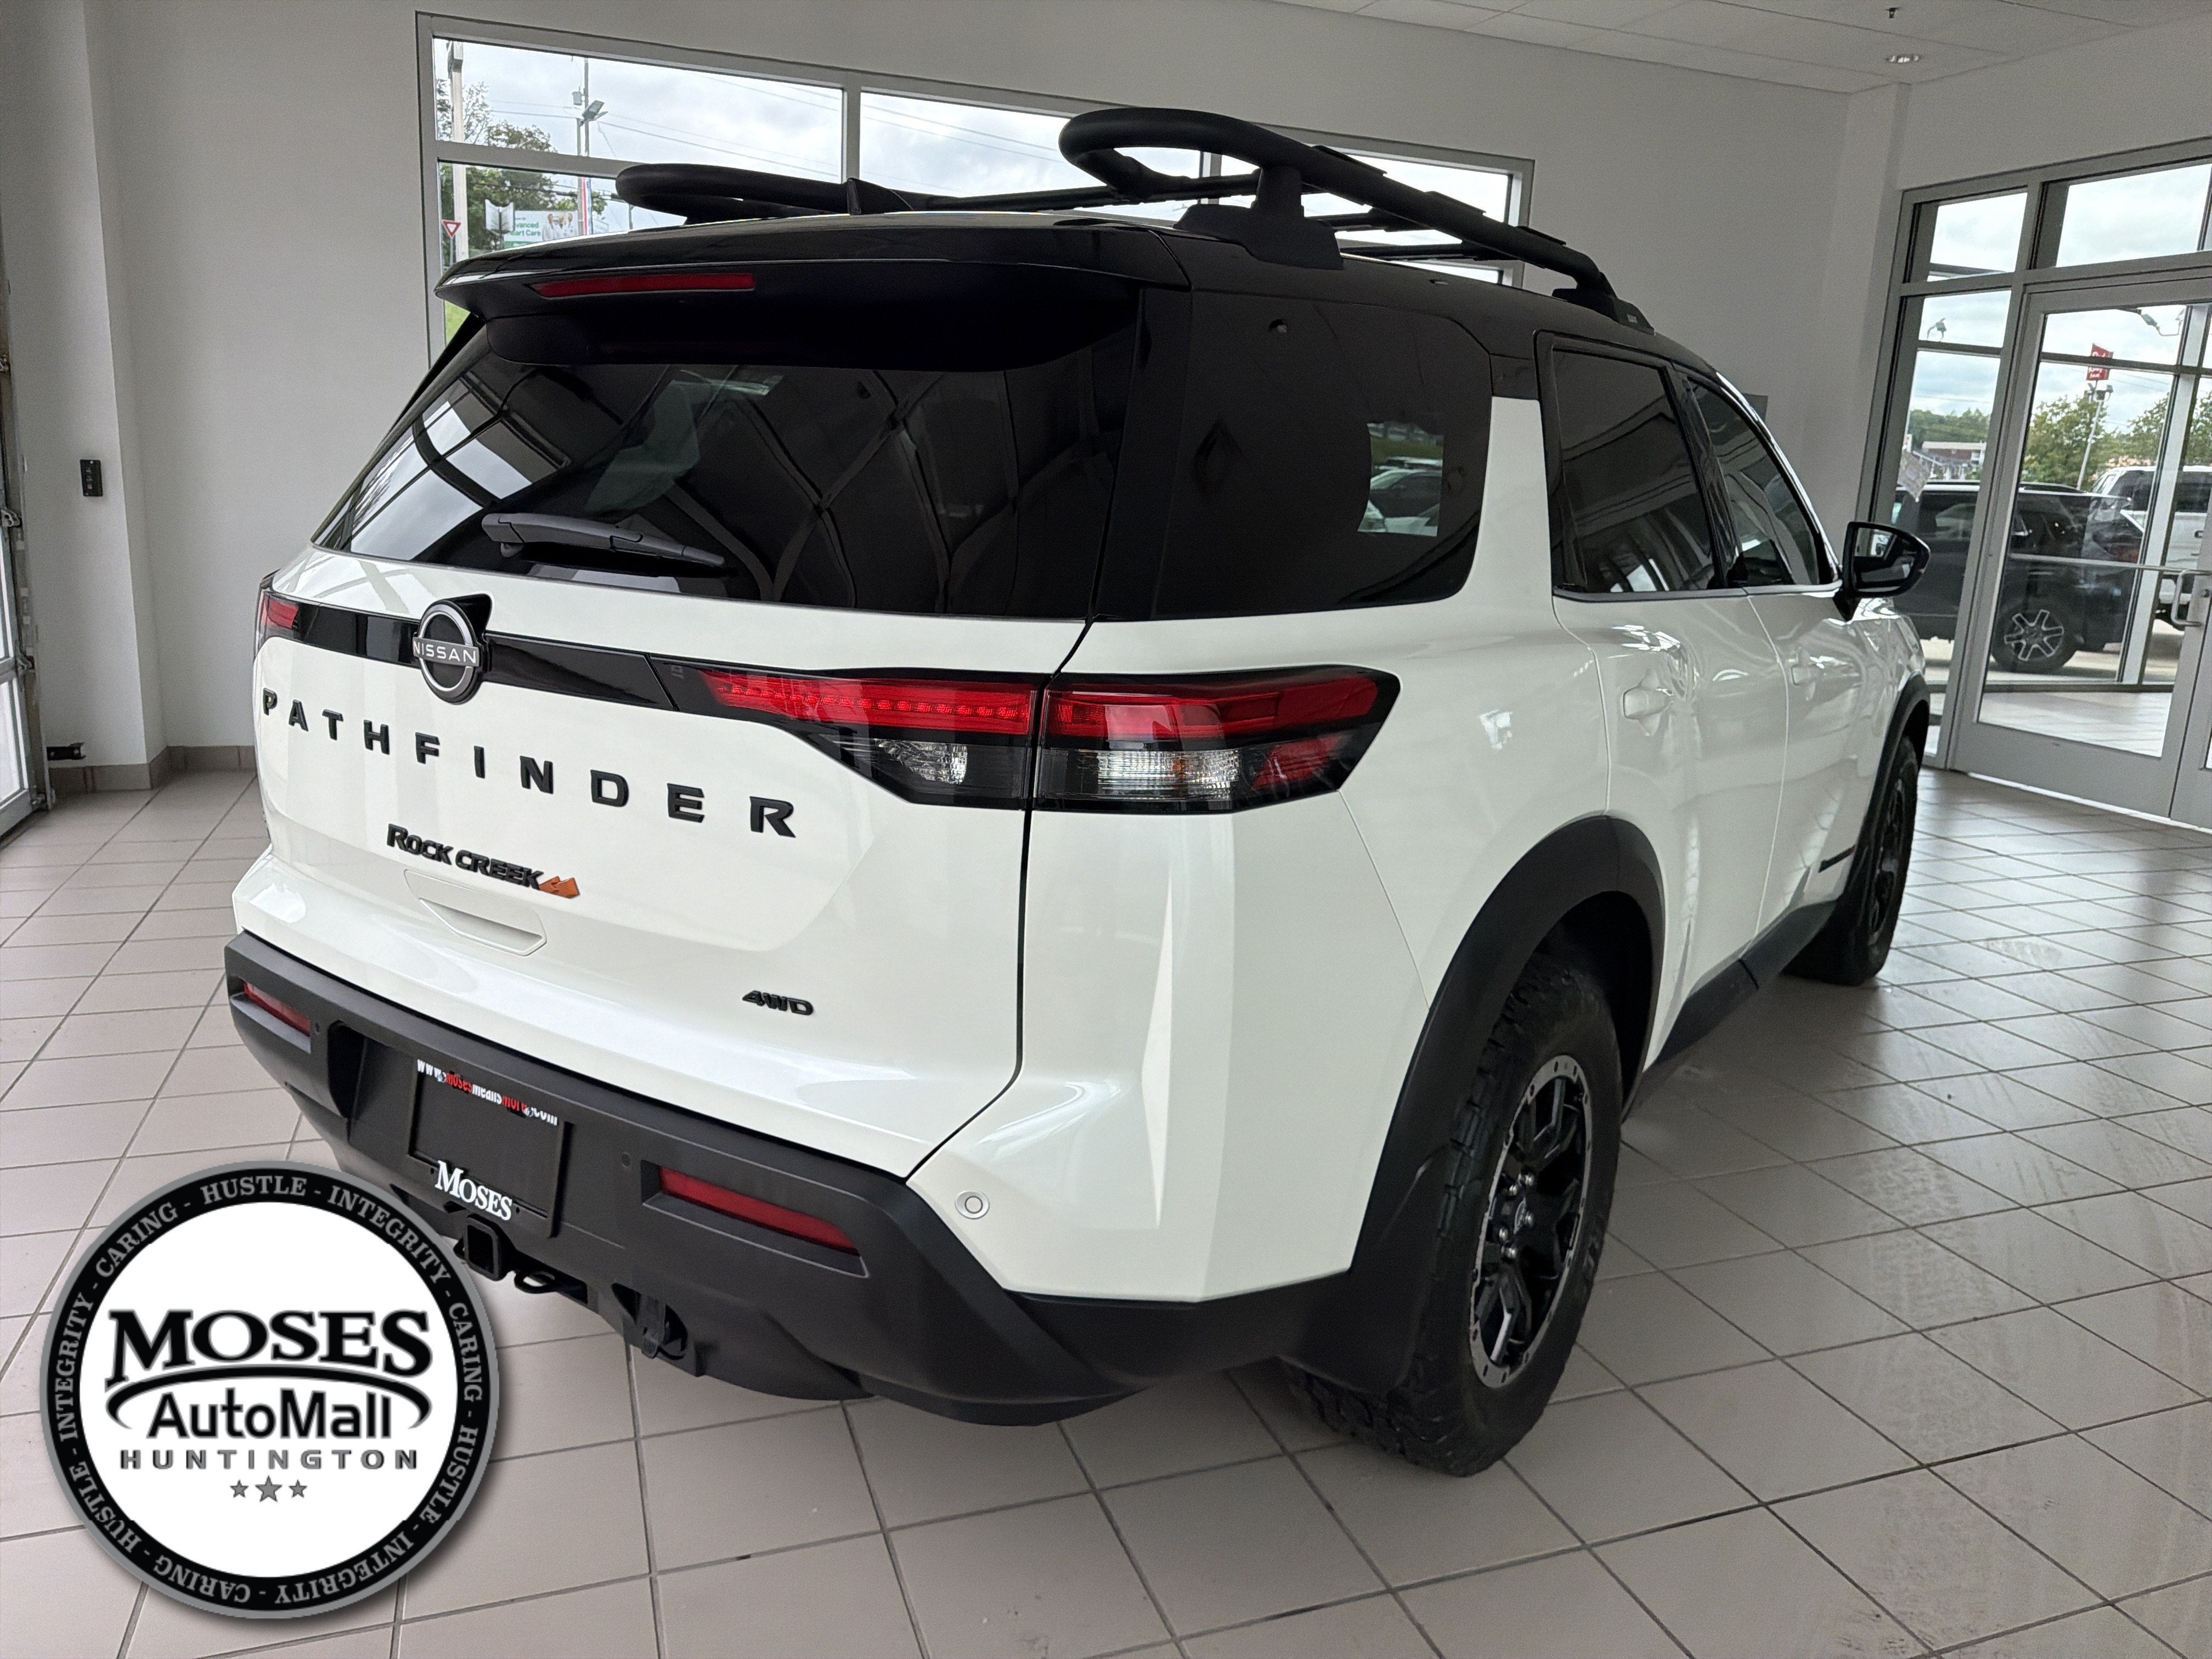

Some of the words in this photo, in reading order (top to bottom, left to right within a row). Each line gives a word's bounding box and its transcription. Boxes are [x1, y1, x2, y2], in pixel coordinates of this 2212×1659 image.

[413, 640, 476, 664] NISSAN
[263, 687, 797, 838] PATHFINDER
[386, 822, 454, 866] ROCK
[455, 849, 544, 890] CREEK
[742, 990, 814, 1016] 4WD
[435, 1160, 513, 1221] MOSES
